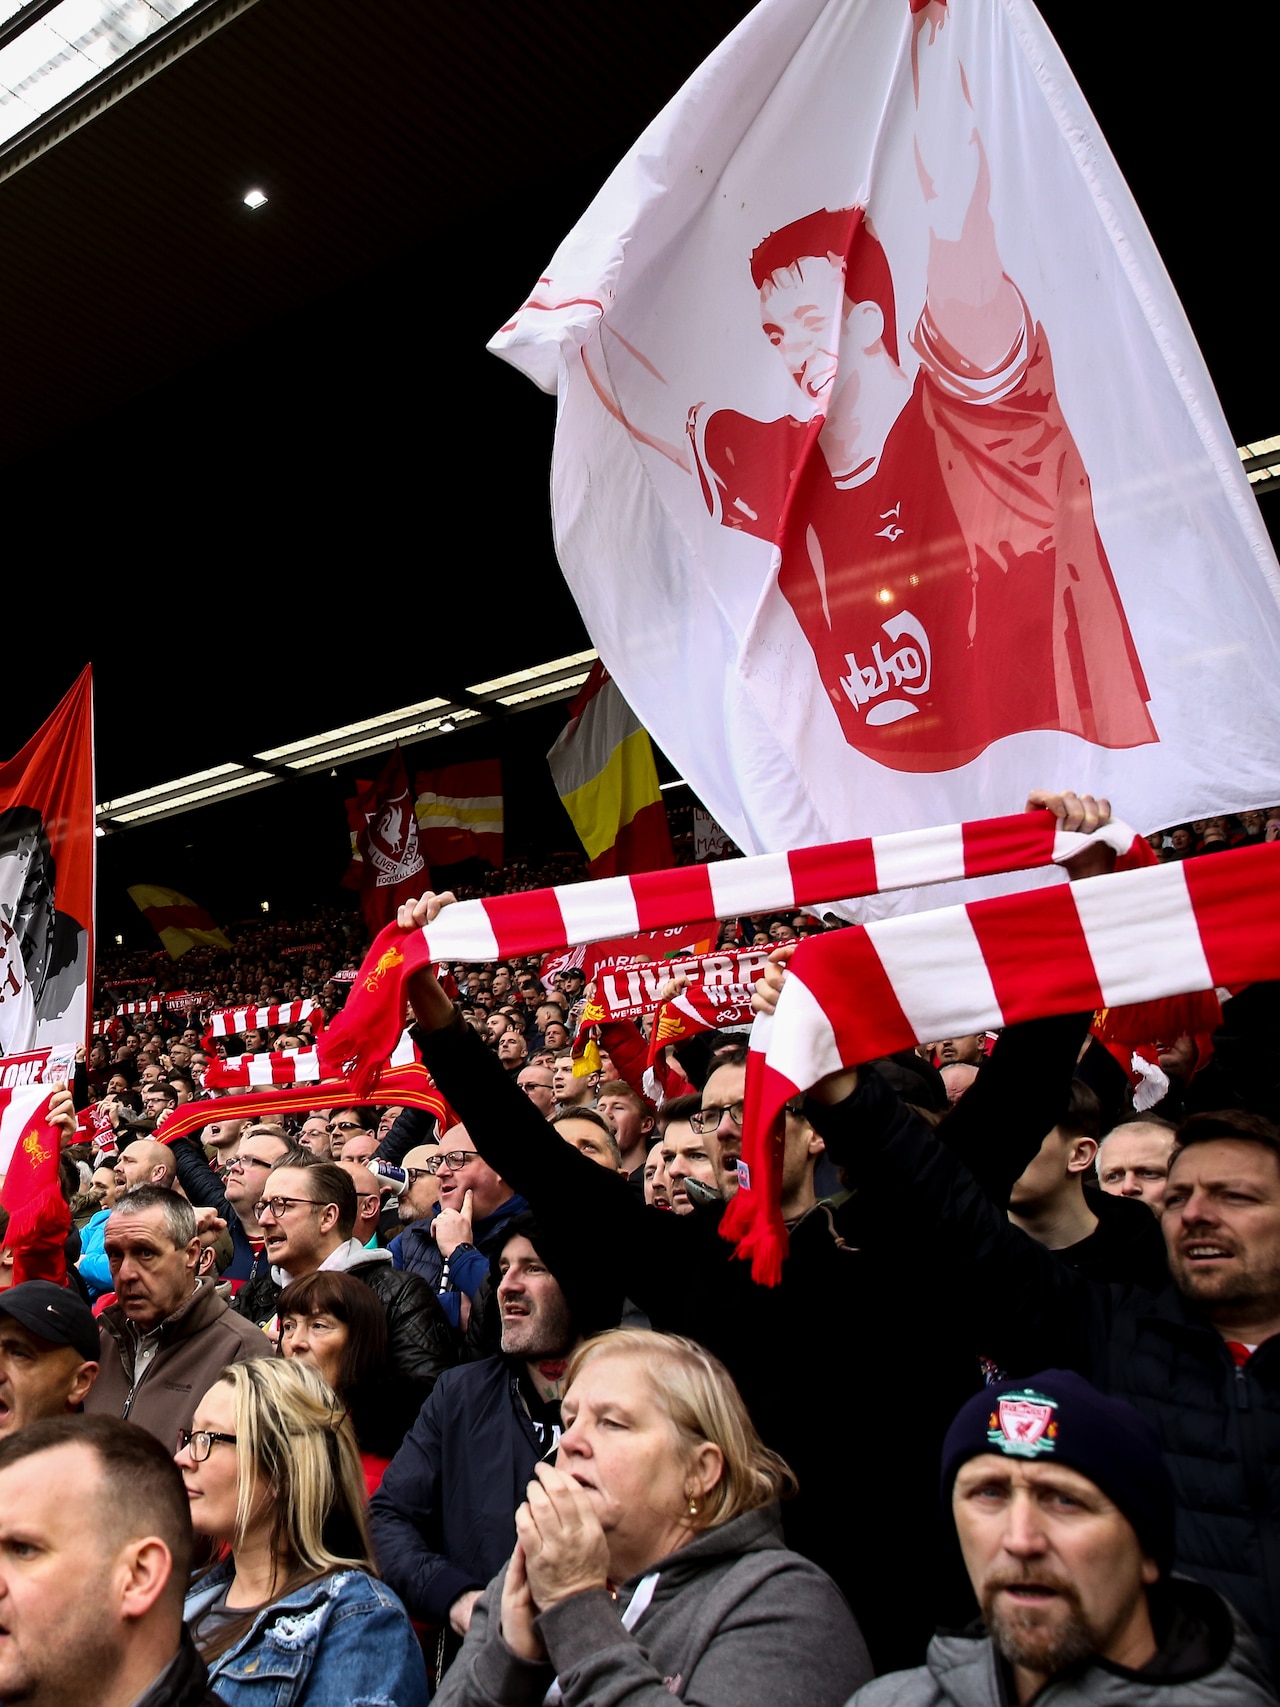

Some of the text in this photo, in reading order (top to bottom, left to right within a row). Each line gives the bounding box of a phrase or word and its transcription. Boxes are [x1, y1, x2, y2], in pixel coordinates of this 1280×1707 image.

[615, 960, 666, 973] POETRY
[670, 957, 684, 966] IN
[746, 942, 775, 952] TRA
[611, 1006, 638, 1020] WE'RE
